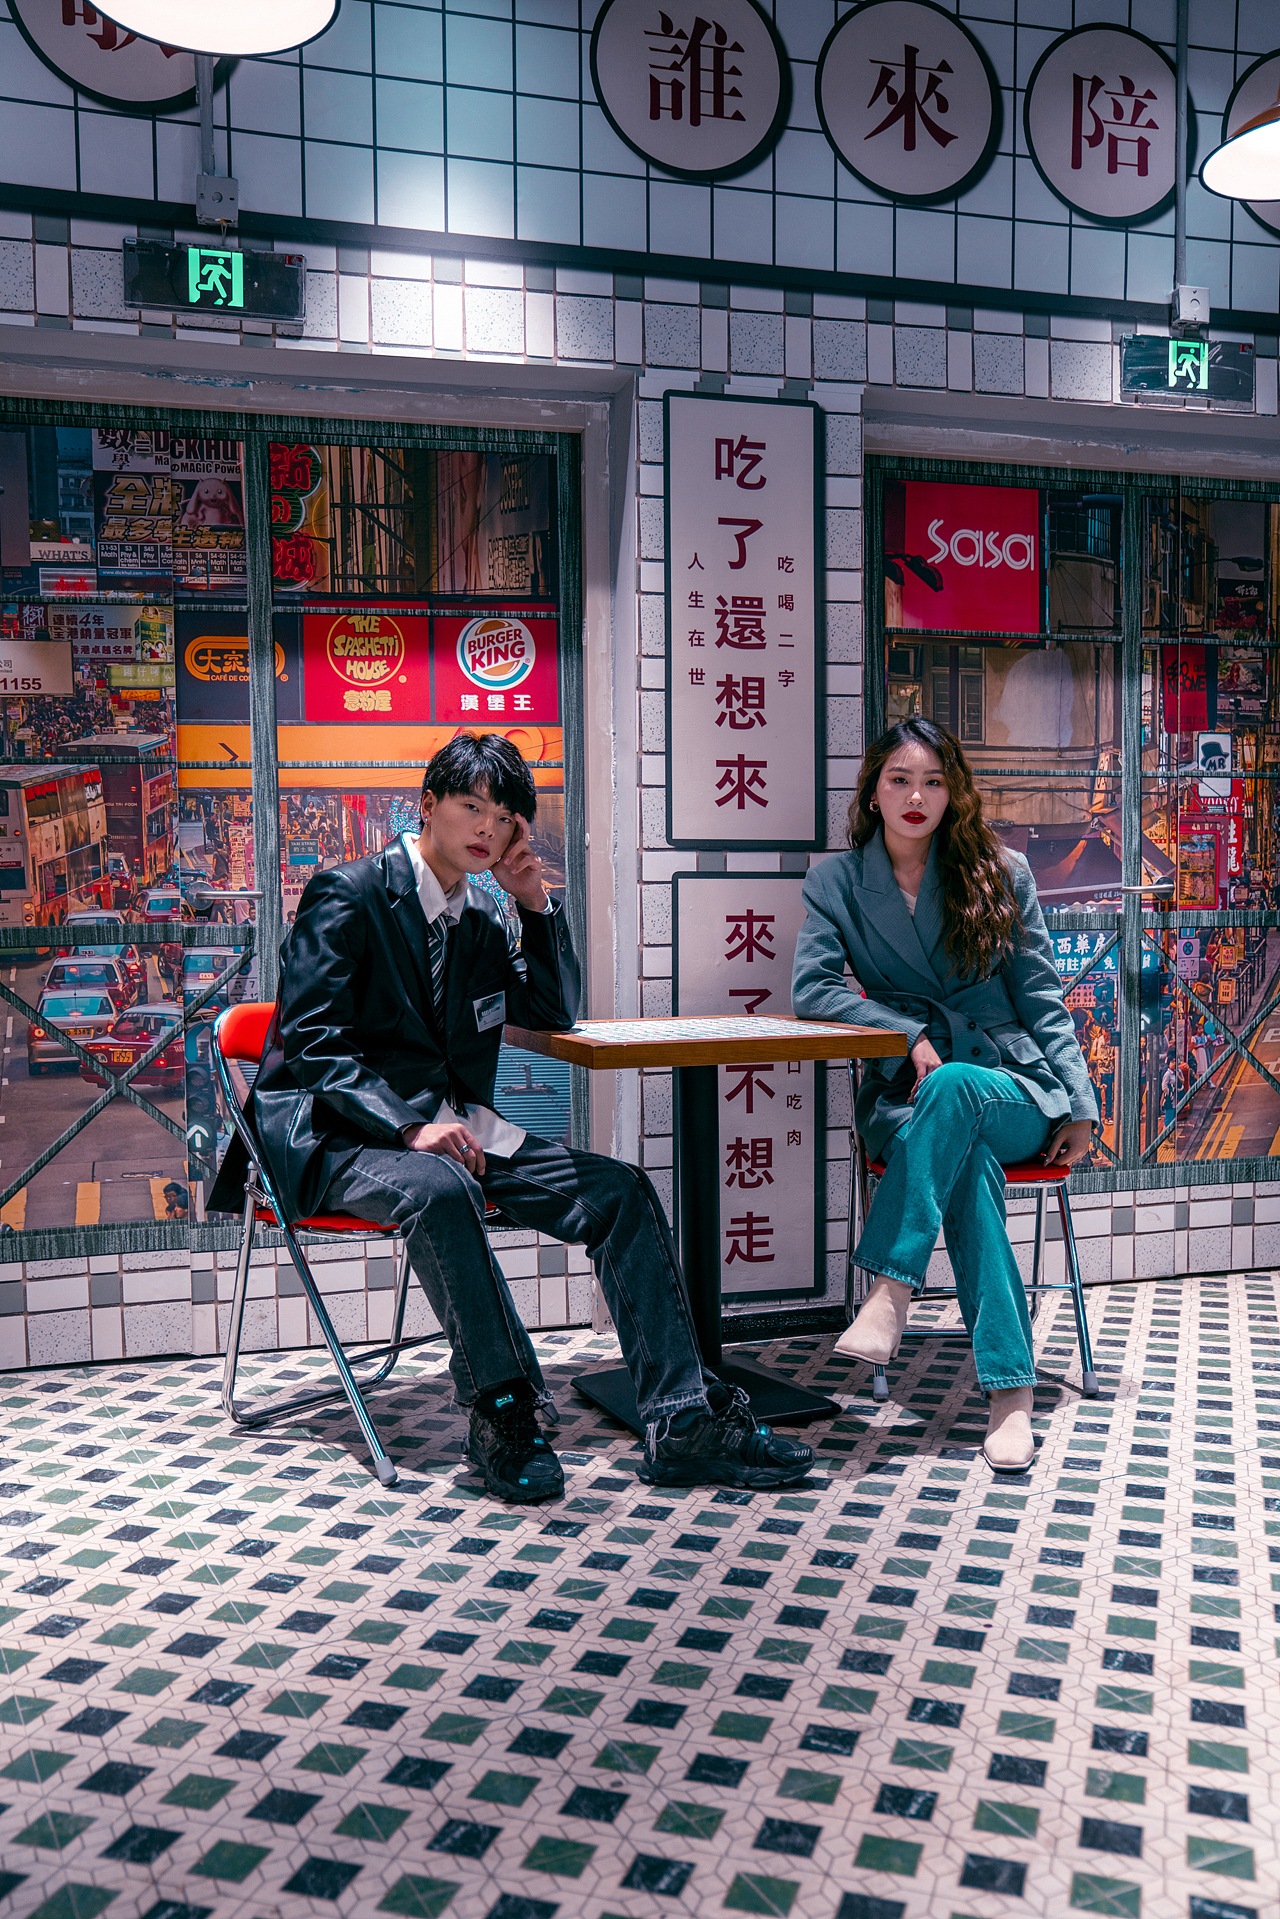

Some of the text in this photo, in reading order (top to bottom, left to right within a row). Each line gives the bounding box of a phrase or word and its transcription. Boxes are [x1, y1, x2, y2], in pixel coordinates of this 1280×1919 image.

[643, 10, 746, 127] 誰
[864, 44, 958, 152] 來
[1069, 72, 1160, 178] 陪
[38, 550, 88, 560] WHAT'S
[347, 615, 381, 633] THE
[688, 552, 706, 687] 人生在世
[714, 434, 769, 810] 吃了還想來
[777, 555, 796, 689] 吃喝二字
[468, 628, 523, 655] BURGER
[199, 649, 250, 674] 大家
[346, 659, 391, 681] HOUSE
[471, 641, 525, 672] KING
[343, 690, 393, 712] 意粉屋
[461, 694, 532, 711] 漢堡王
